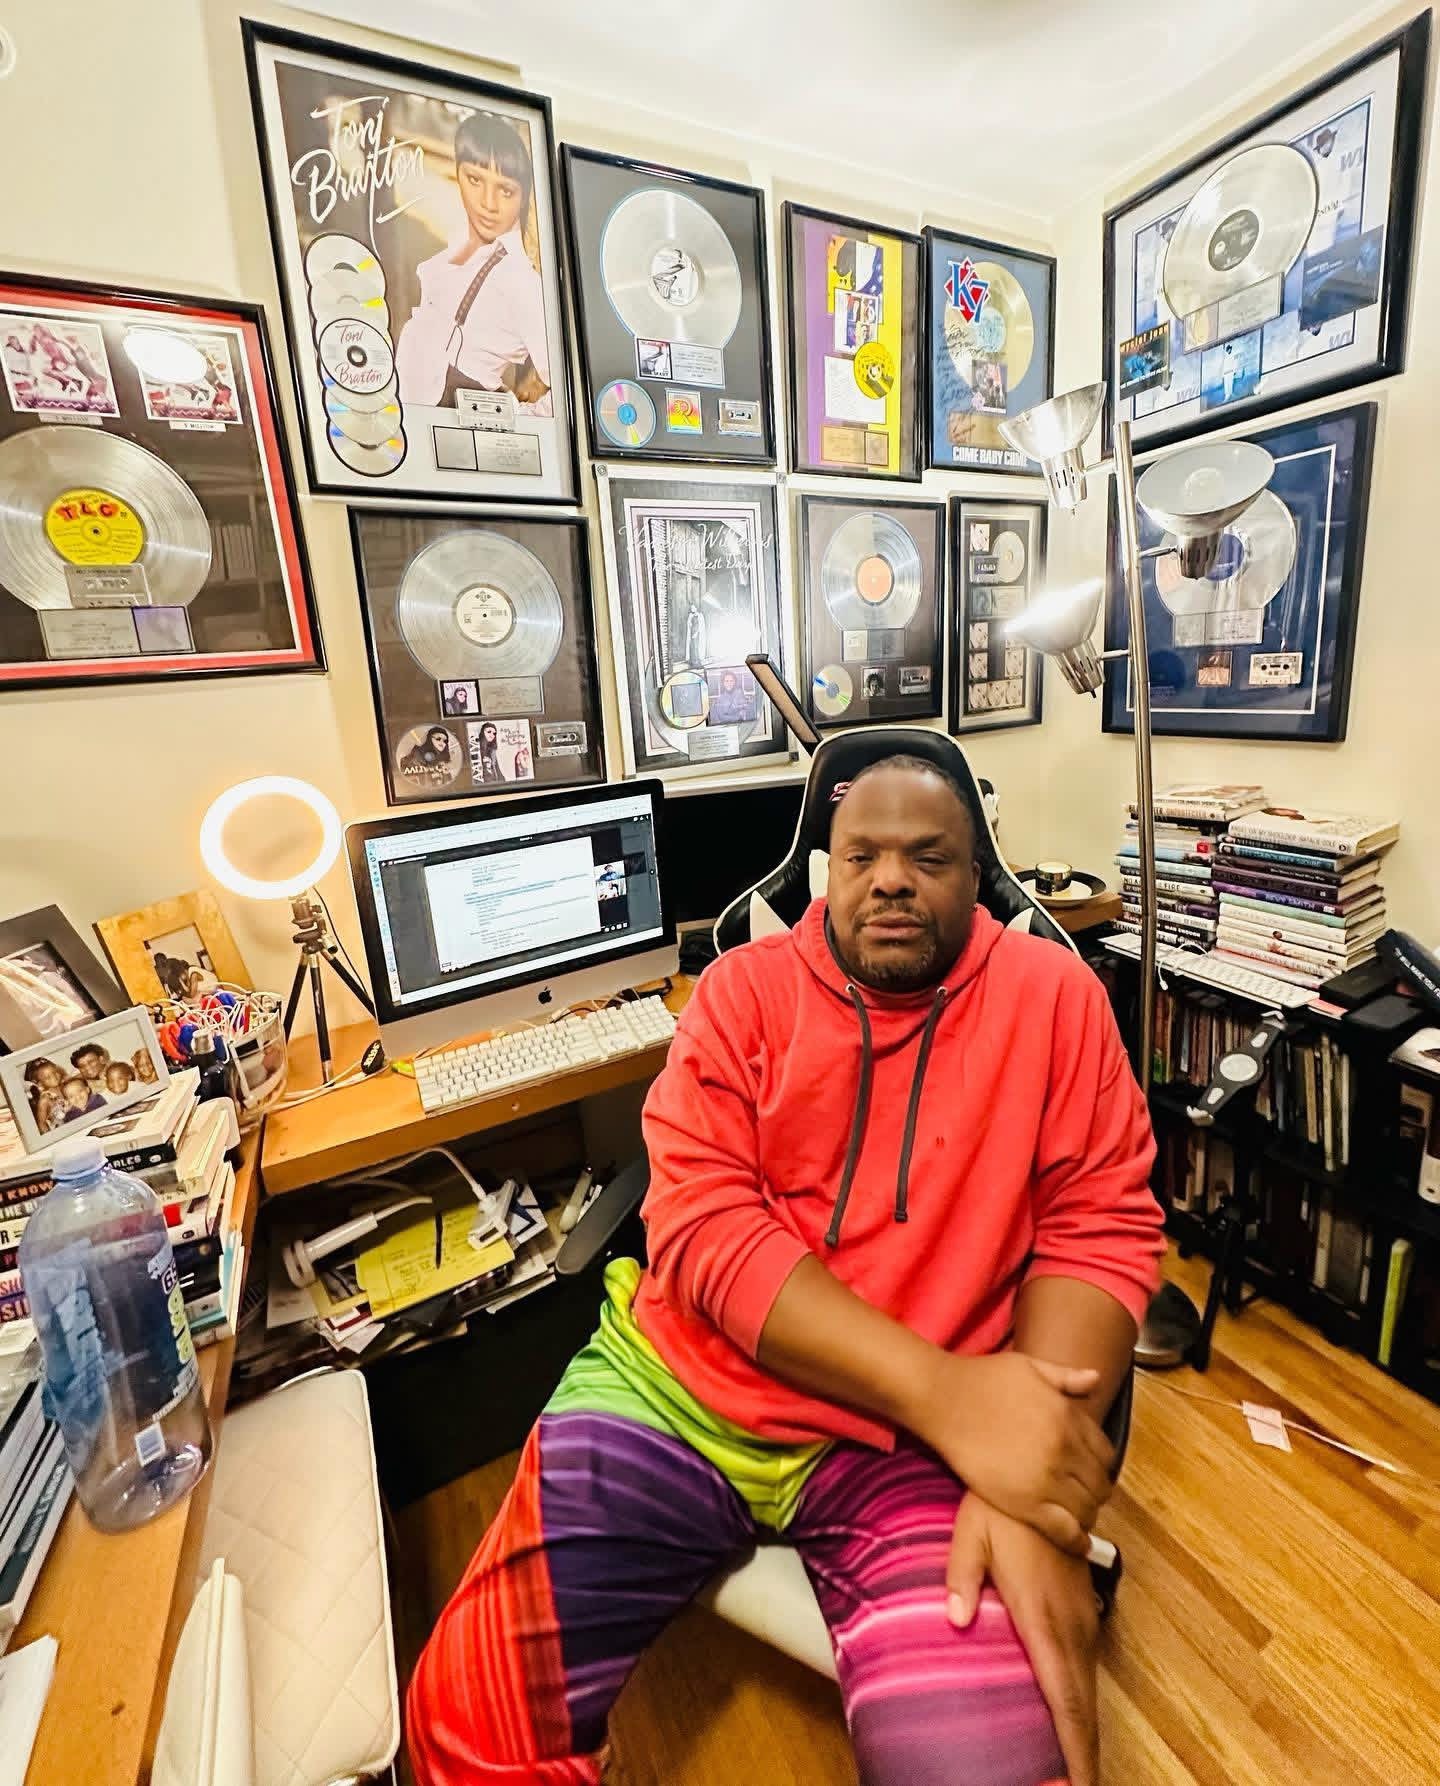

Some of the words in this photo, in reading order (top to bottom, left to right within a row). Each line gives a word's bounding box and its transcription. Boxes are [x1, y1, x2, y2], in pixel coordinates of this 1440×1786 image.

[309, 95, 390, 153] Toni
[291, 136, 424, 224] Braxton
[947, 260, 991, 326] K7
[1164, 882, 1180, 891] FIRE
[106, 1154, 142, 1170] ARLES
